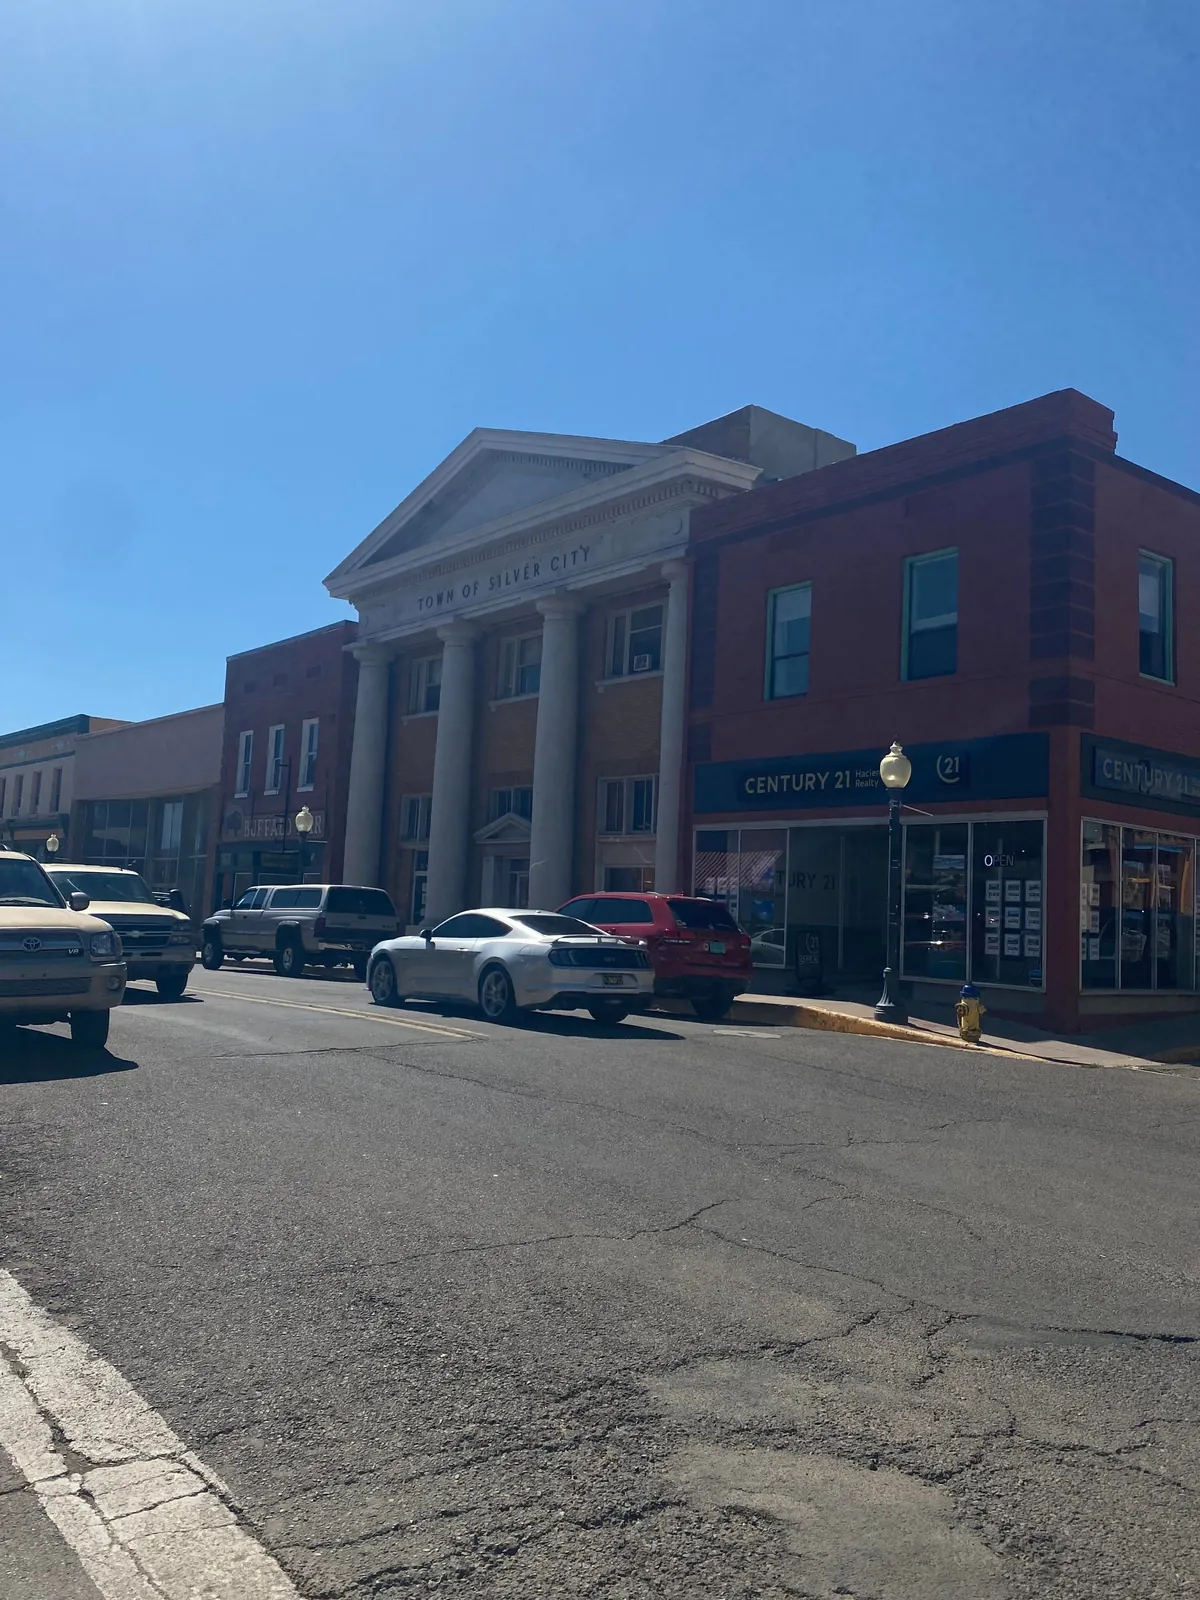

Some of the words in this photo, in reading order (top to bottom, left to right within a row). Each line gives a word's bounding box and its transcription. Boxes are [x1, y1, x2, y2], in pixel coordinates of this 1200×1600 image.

[417, 588, 455, 611] TOWN
[461, 581, 480, 599] OF
[488, 562, 541, 591] SILVER
[550, 544, 591, 572] CITY
[744, 771, 830, 794] CENTURY
[834, 770, 851, 789] 21
[855, 779, 880, 789] Realty
[1102, 758, 1173, 791] CENTURY
[1176, 774, 1188, 795] 21
[984, 854, 1015, 867] OPEN
[823, 874, 836, 890] 21
